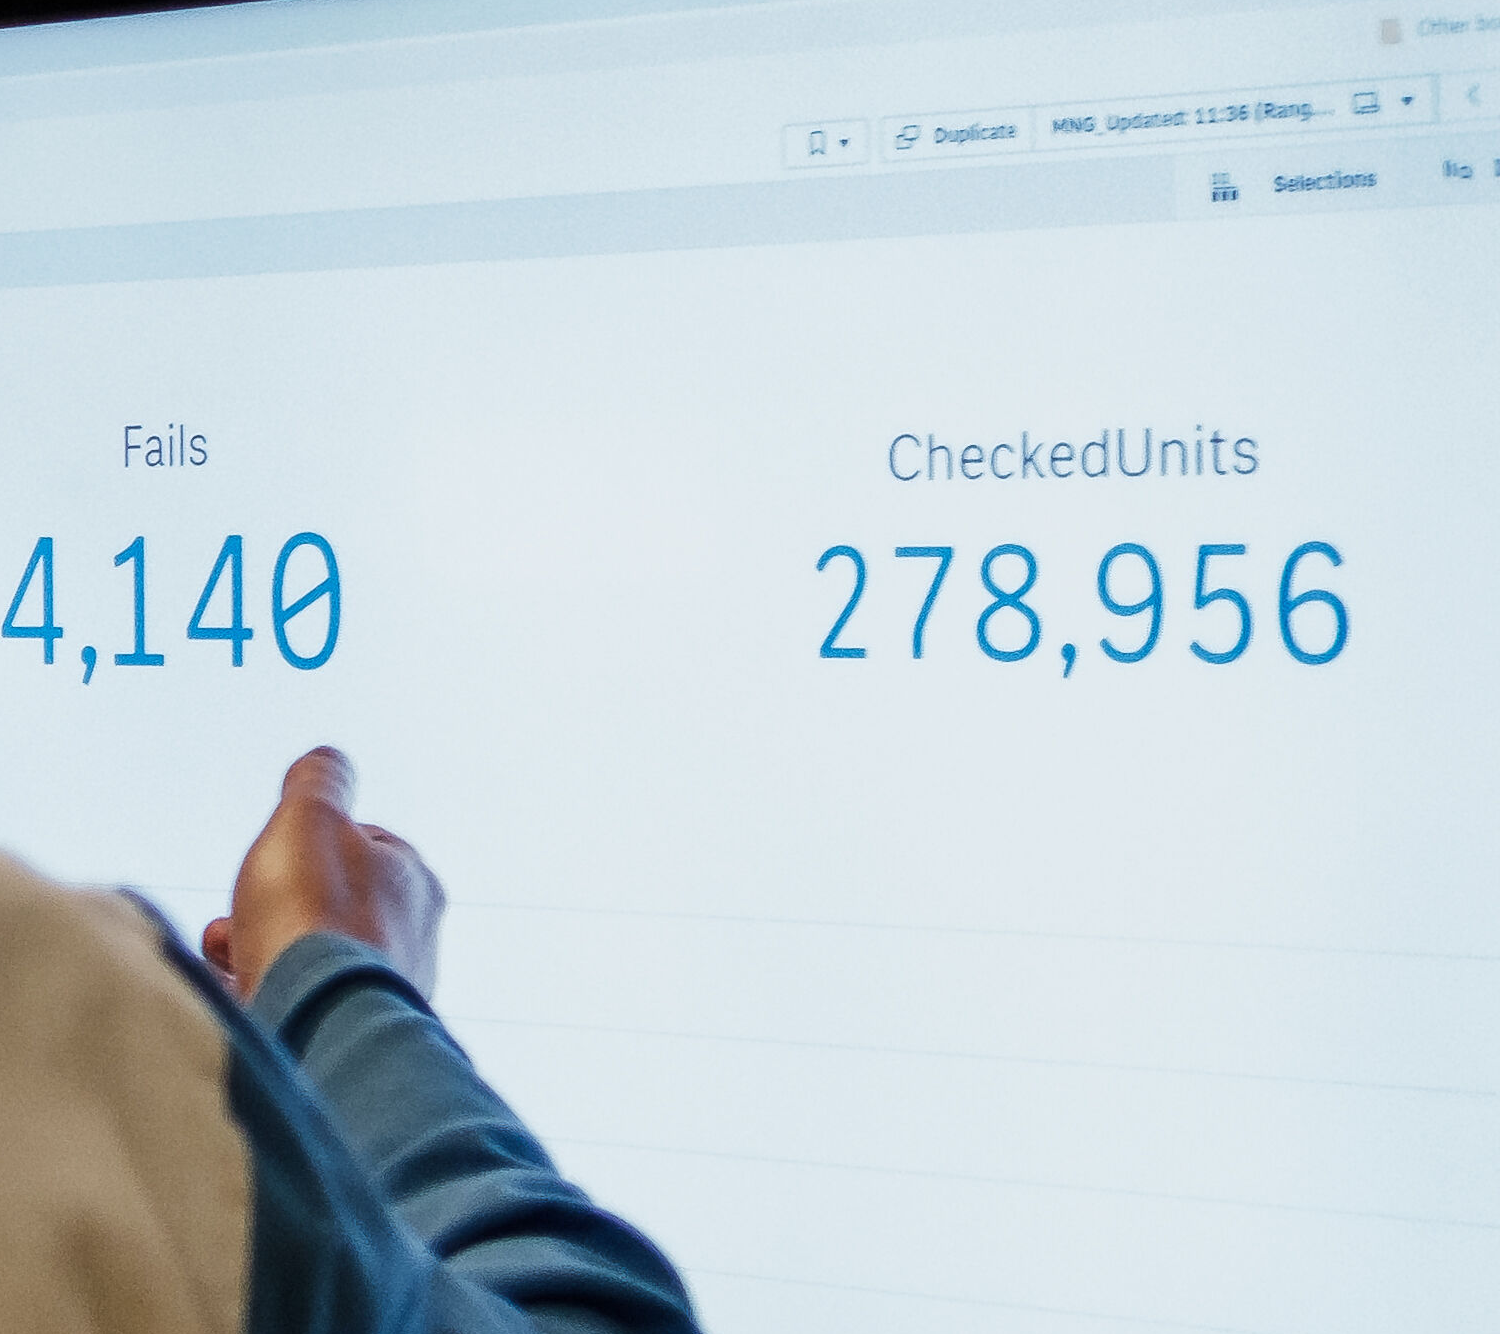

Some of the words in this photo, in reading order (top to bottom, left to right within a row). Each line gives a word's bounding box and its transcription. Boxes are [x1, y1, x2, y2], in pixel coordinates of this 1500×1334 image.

[933, 124, 1017, 146] Duplicate
[1273, 169, 1378, 193] Selections
[123, 423, 209, 468] Fails
[888, 424, 1261, 482] CheckedUnits
[1, 531, 342, 685] 4,140
[816, 540, 1351, 680] 278,956
